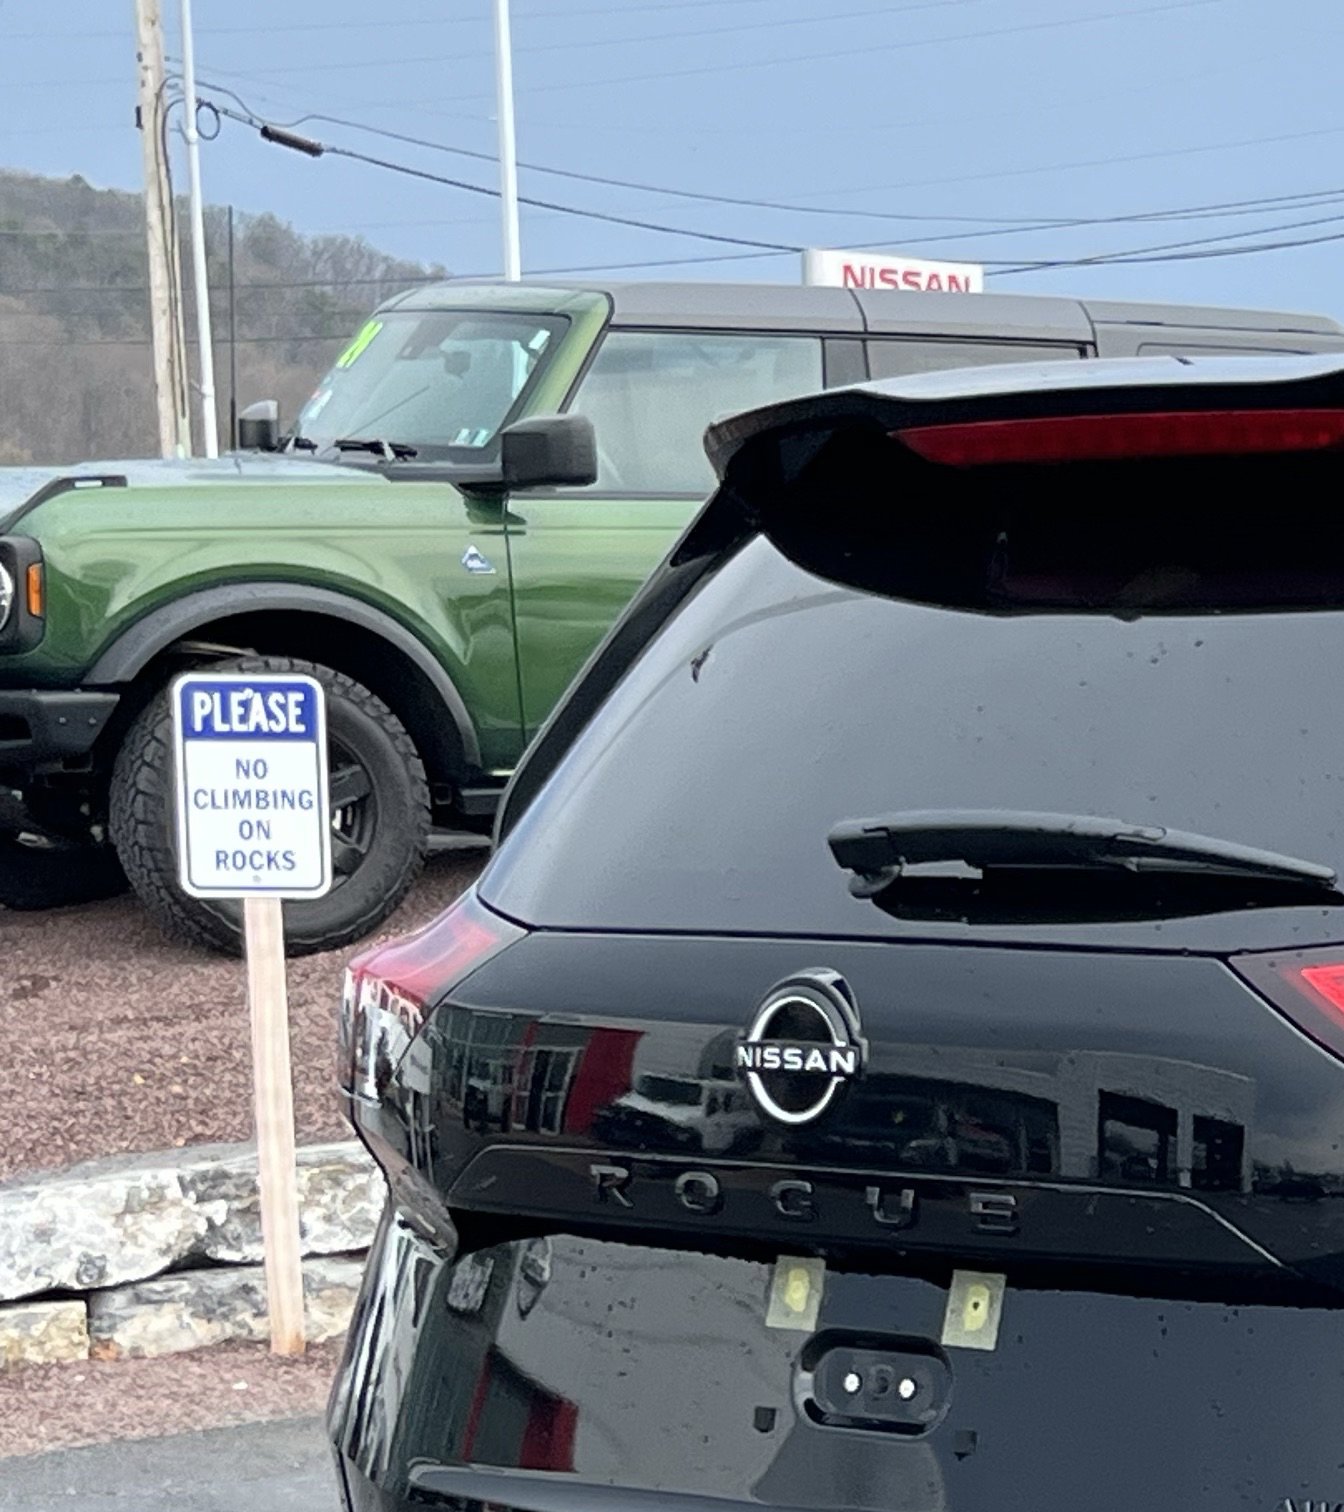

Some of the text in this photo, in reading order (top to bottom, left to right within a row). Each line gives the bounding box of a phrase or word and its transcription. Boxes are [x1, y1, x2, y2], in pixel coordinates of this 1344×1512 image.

[842, 264, 970, 293] NISSAN
[193, 690, 306, 733] PLEASE
[235, 758, 268, 779] NO
[193, 788, 314, 810] CLIMBING
[238, 819, 272, 840] ON
[215, 850, 296, 871] ROCKS
[738, 1045, 855, 1074] NISSAN
[588, 1163, 1020, 1235] ROGUE
